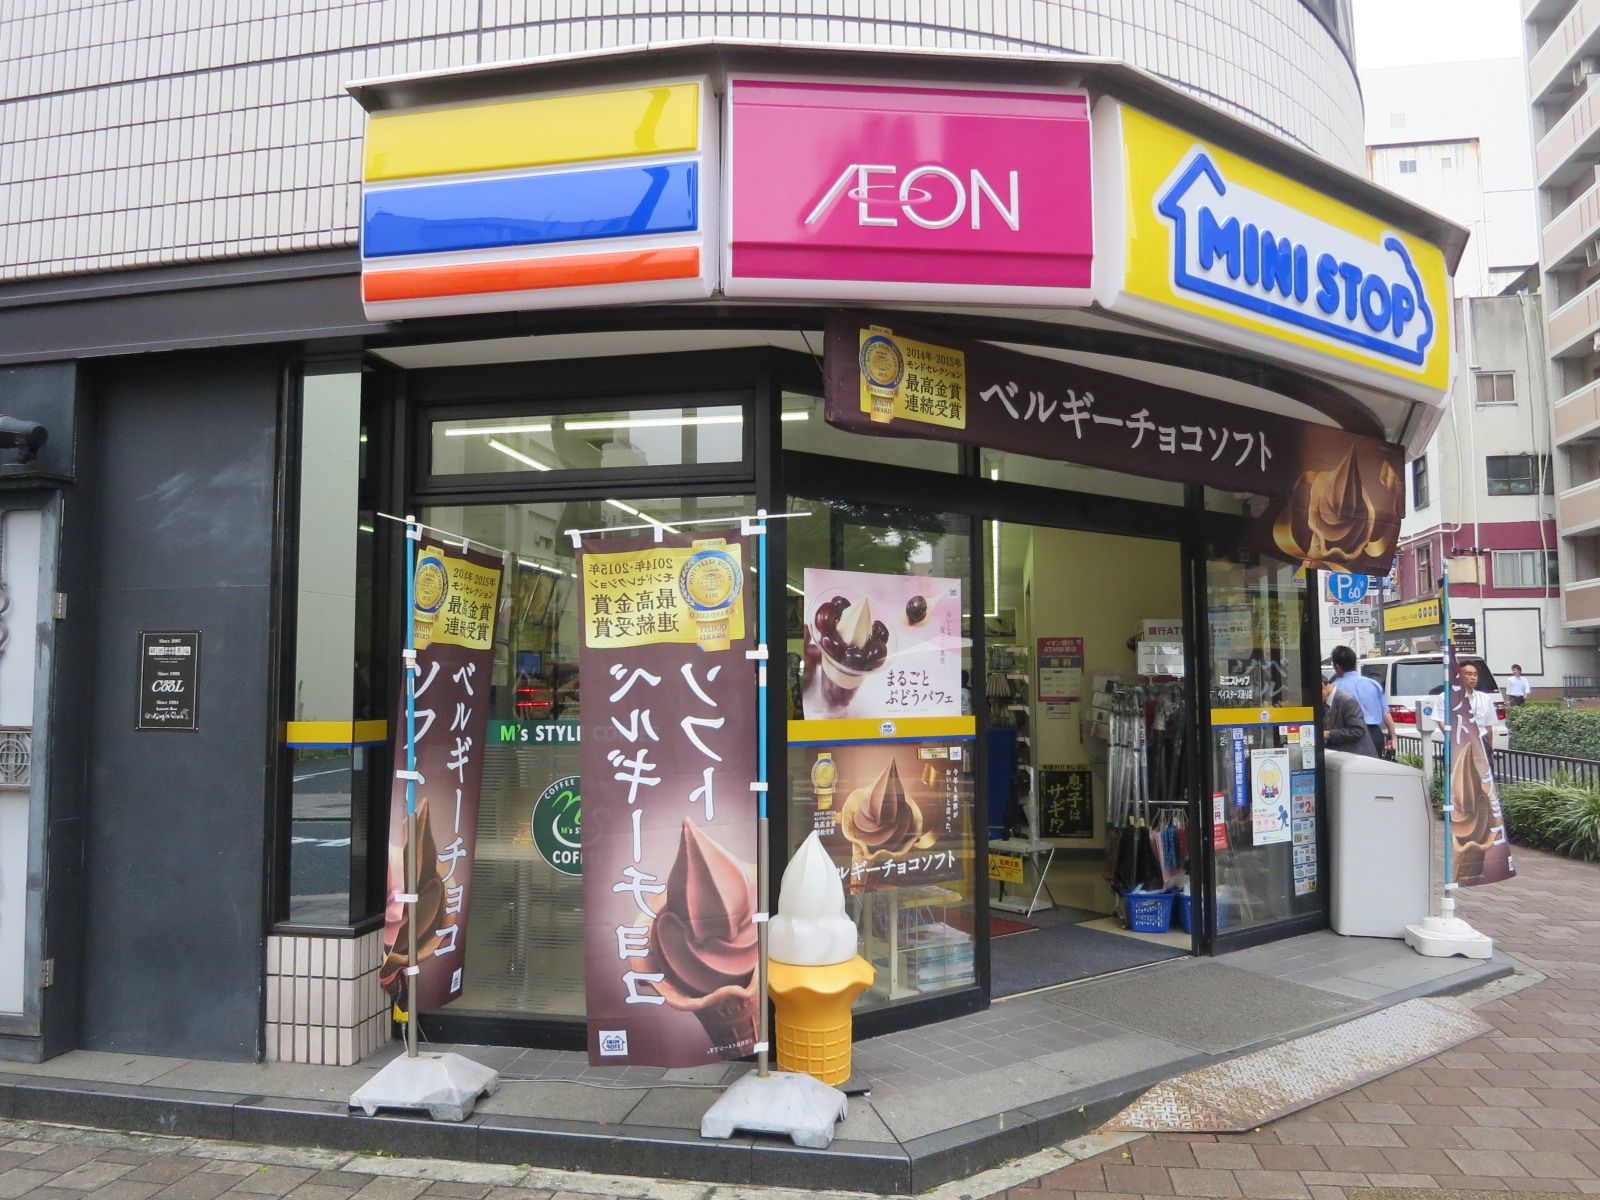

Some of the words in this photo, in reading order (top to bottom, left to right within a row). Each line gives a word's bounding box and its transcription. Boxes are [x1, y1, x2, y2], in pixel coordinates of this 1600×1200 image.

[1197, 205, 1308, 304] MINI
[1315, 251, 1416, 338] STOP
[906, 360, 962, 380] モンドセレクション
[906, 373, 962, 401] 最高金賞
[904, 394, 962, 421] 連続受賞
[979, 379, 1274, 473] ベルギーチョコソフト
[1336, 574, 1353, 599] P
[886, 669, 930, 687] まるごと
[1219, 675, 1251, 686] ミニストップ
[885, 689, 954, 707] ぶどうパフェ
[500, 724, 529, 742] M's
[544, 777, 575, 800] COFFEE
[433, 661, 477, 957] ベルギーチョコ
[552, 850, 583, 864] COF
